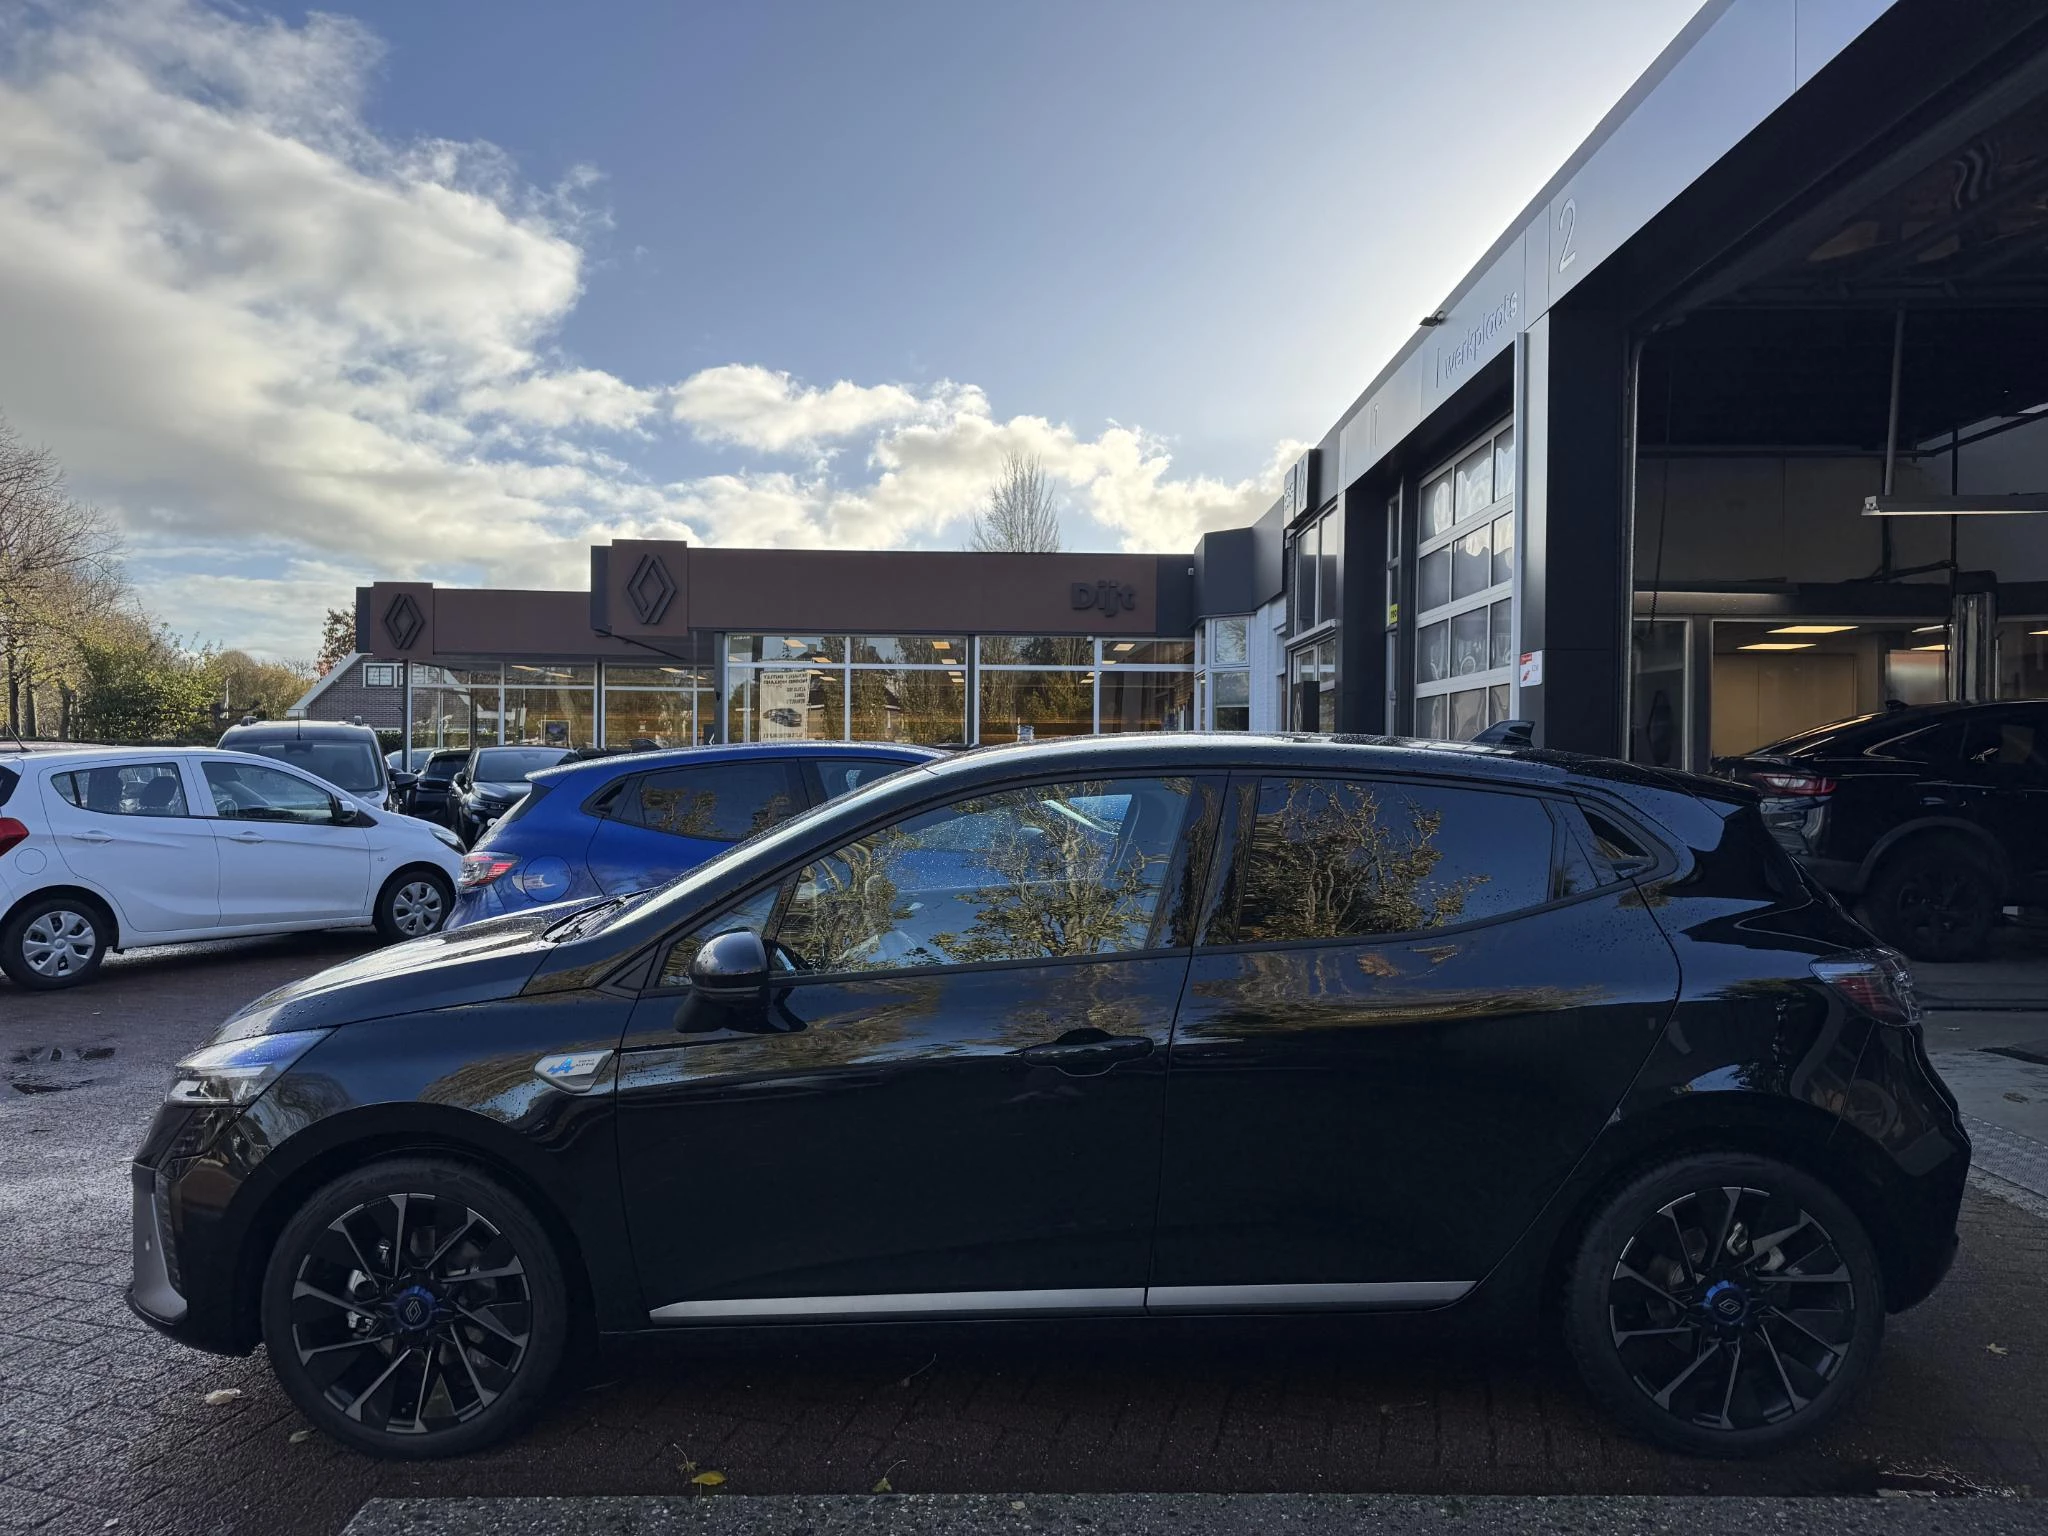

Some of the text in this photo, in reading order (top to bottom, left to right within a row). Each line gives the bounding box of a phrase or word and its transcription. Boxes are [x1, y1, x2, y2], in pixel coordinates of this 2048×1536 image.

[1558, 198, 1576, 273] 2
[1445, 291, 1519, 380] werkplaats
[1071, 580, 1135, 617] Dijt
